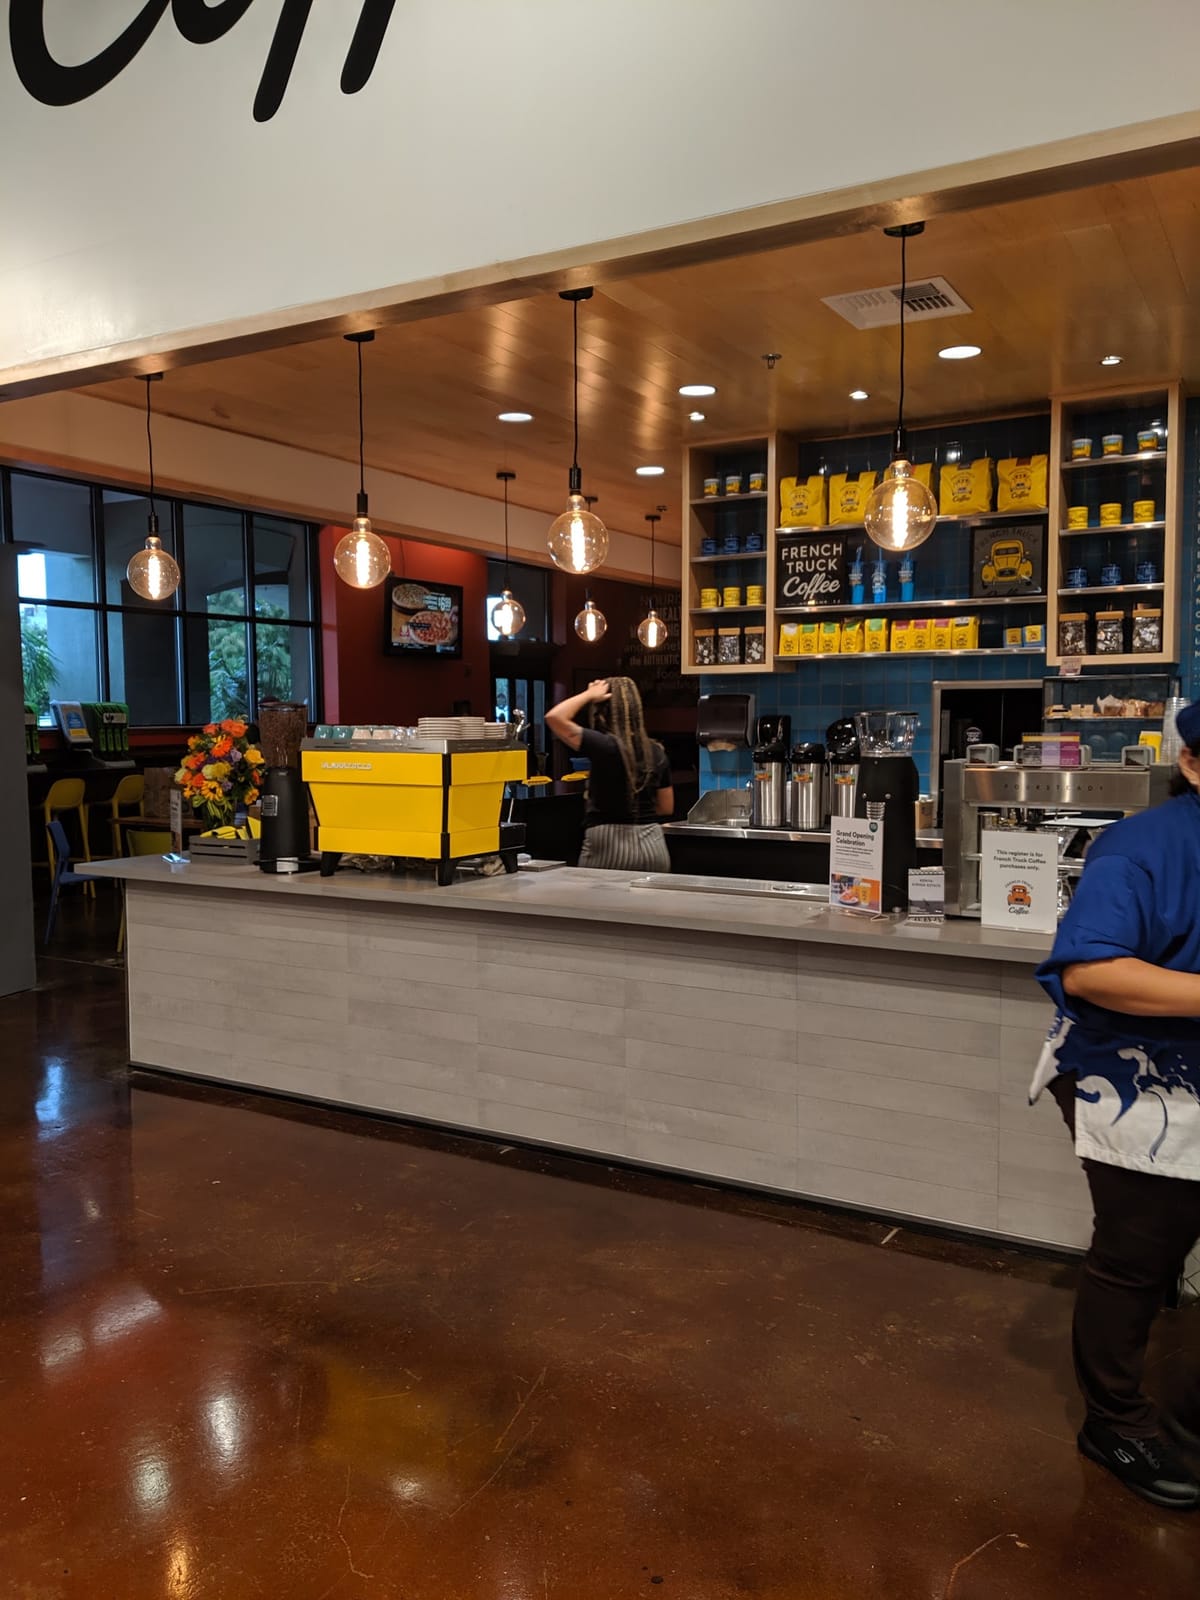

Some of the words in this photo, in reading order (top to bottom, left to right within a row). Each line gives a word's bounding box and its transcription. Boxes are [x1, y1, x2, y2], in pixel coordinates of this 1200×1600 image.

[781, 543, 843, 560] FRENCH
[786, 558, 838, 574] TRUCK
[783, 572, 841, 600] Coffee
[836, 829, 851, 838] Grand
[852, 832, 874, 841] Opening
[836, 837, 865, 847] Celebration
[1028, 857, 1046, 865] Coffee
